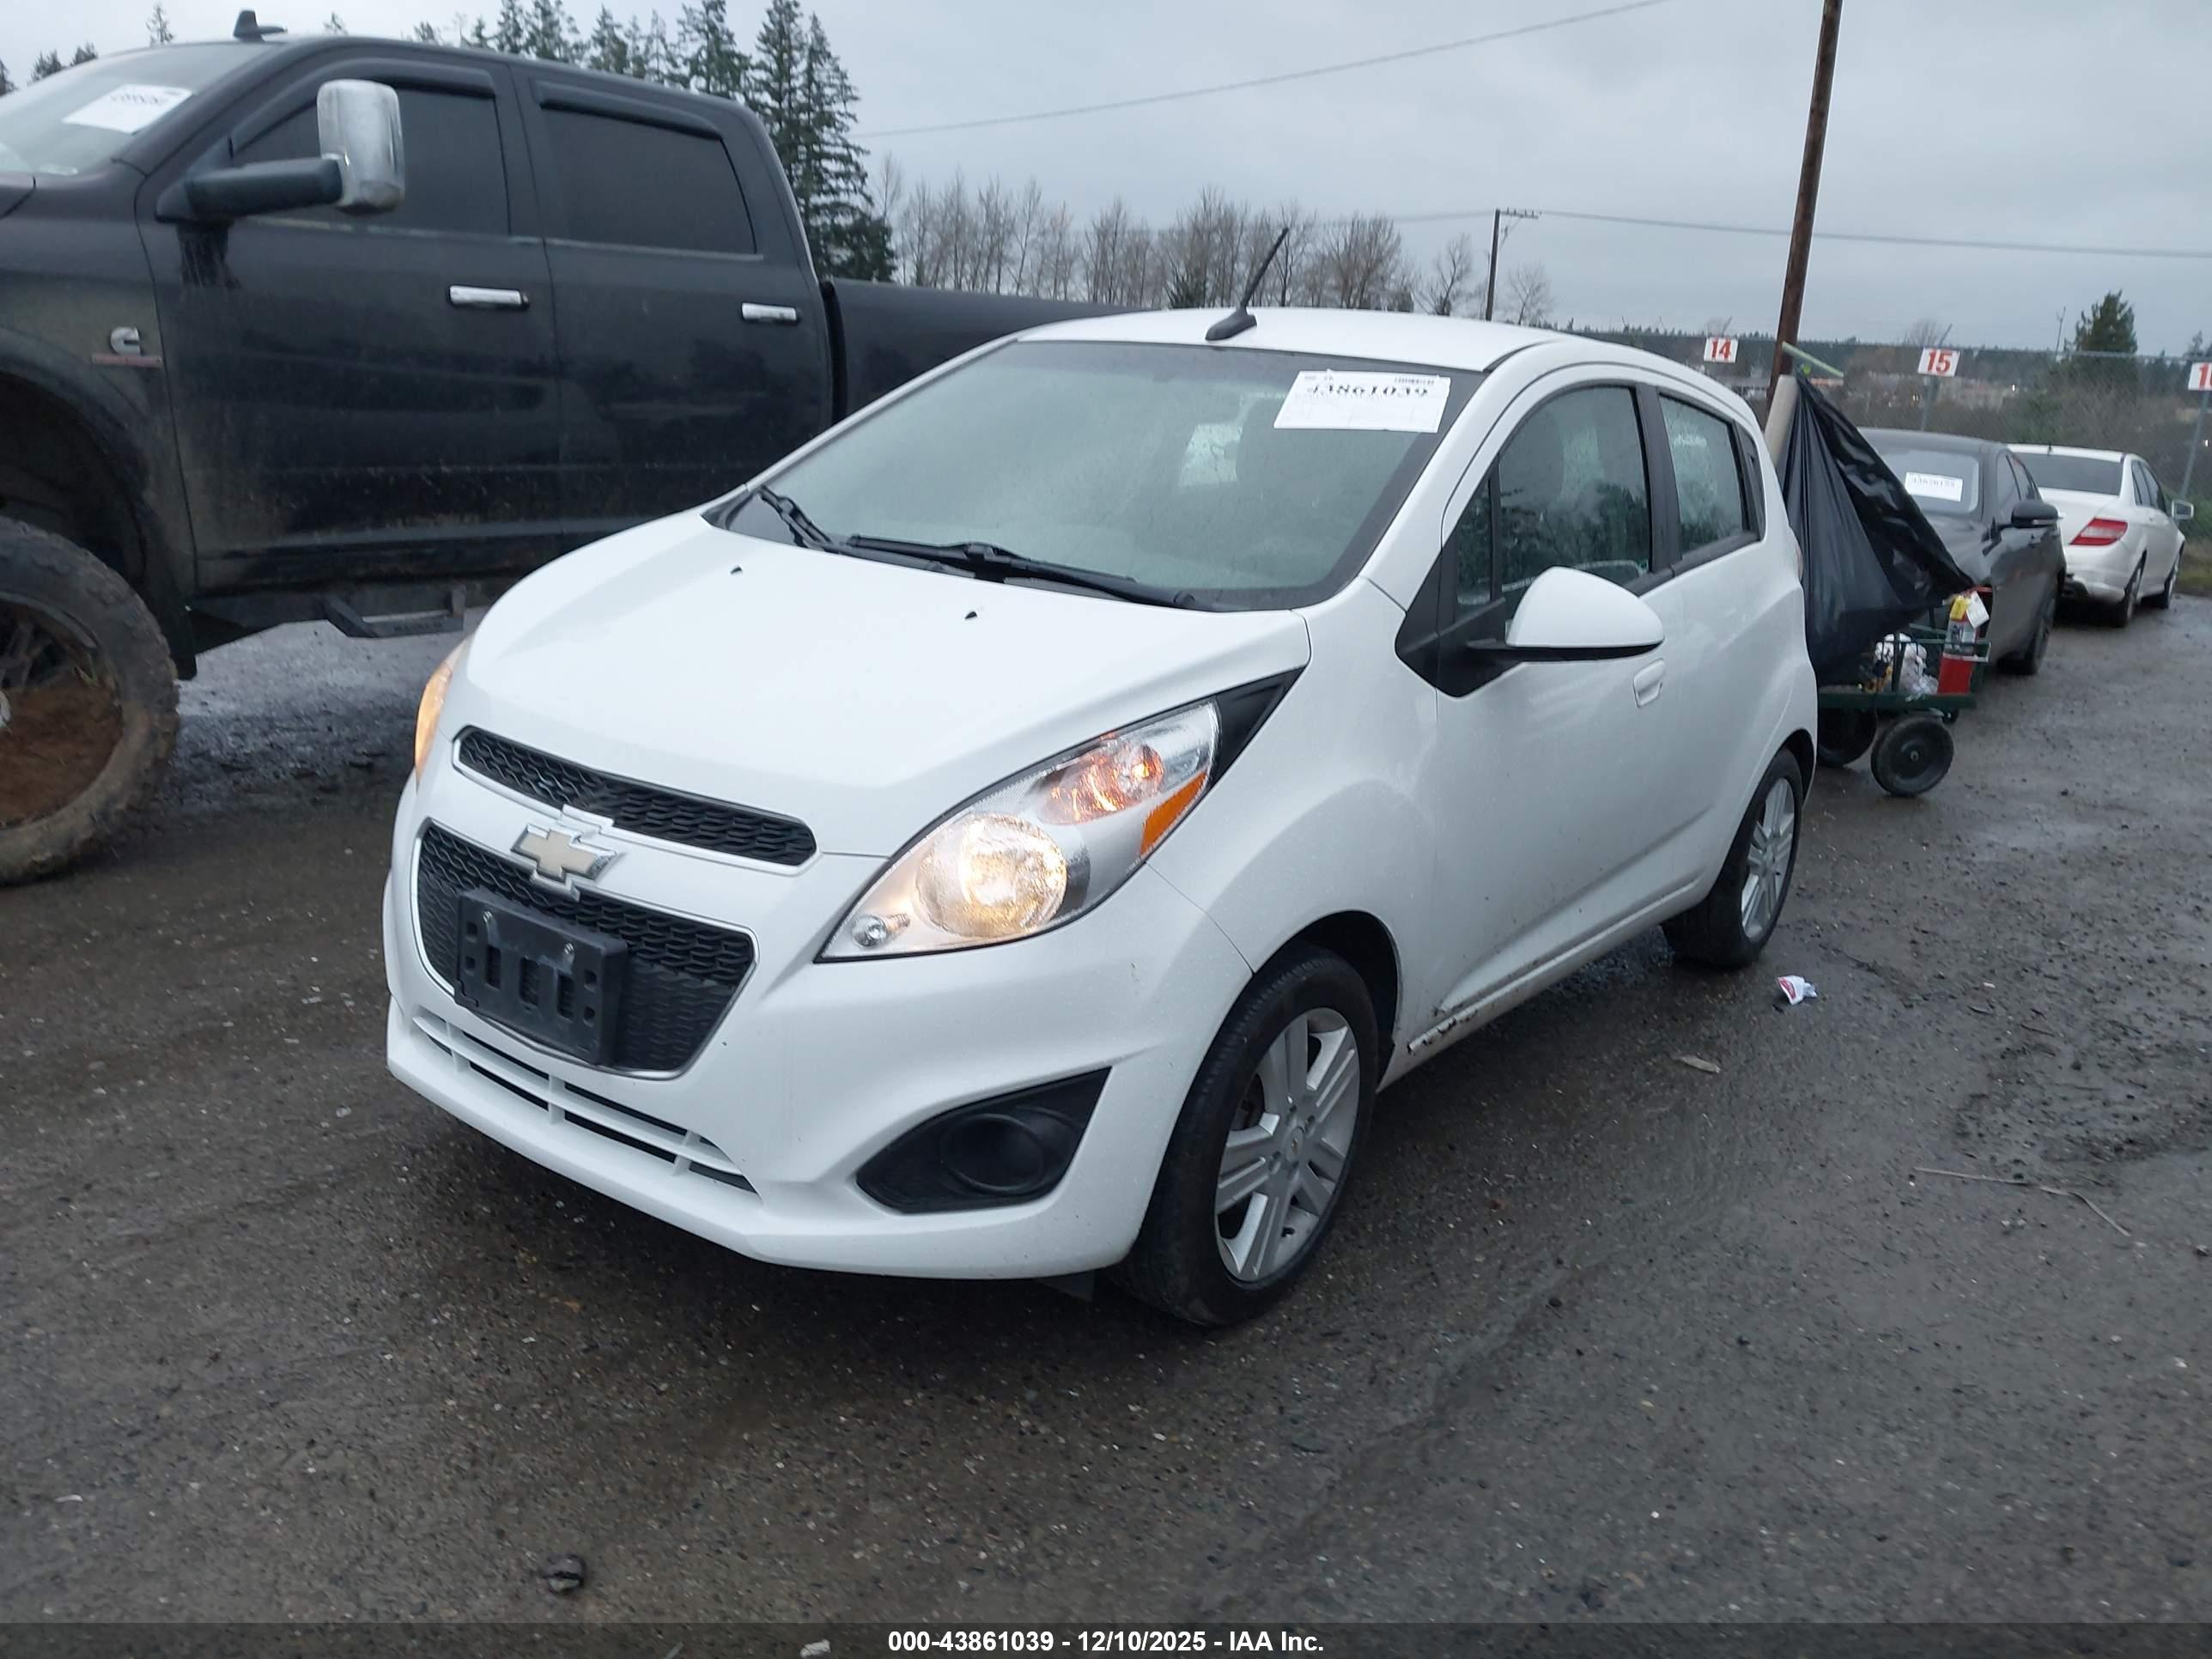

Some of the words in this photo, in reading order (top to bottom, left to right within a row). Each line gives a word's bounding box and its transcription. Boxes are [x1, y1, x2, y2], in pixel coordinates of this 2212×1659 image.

[1711, 337, 1731, 362] 14
[1927, 349, 1952, 376] 15
[2199, 363, 2212, 391] 1
